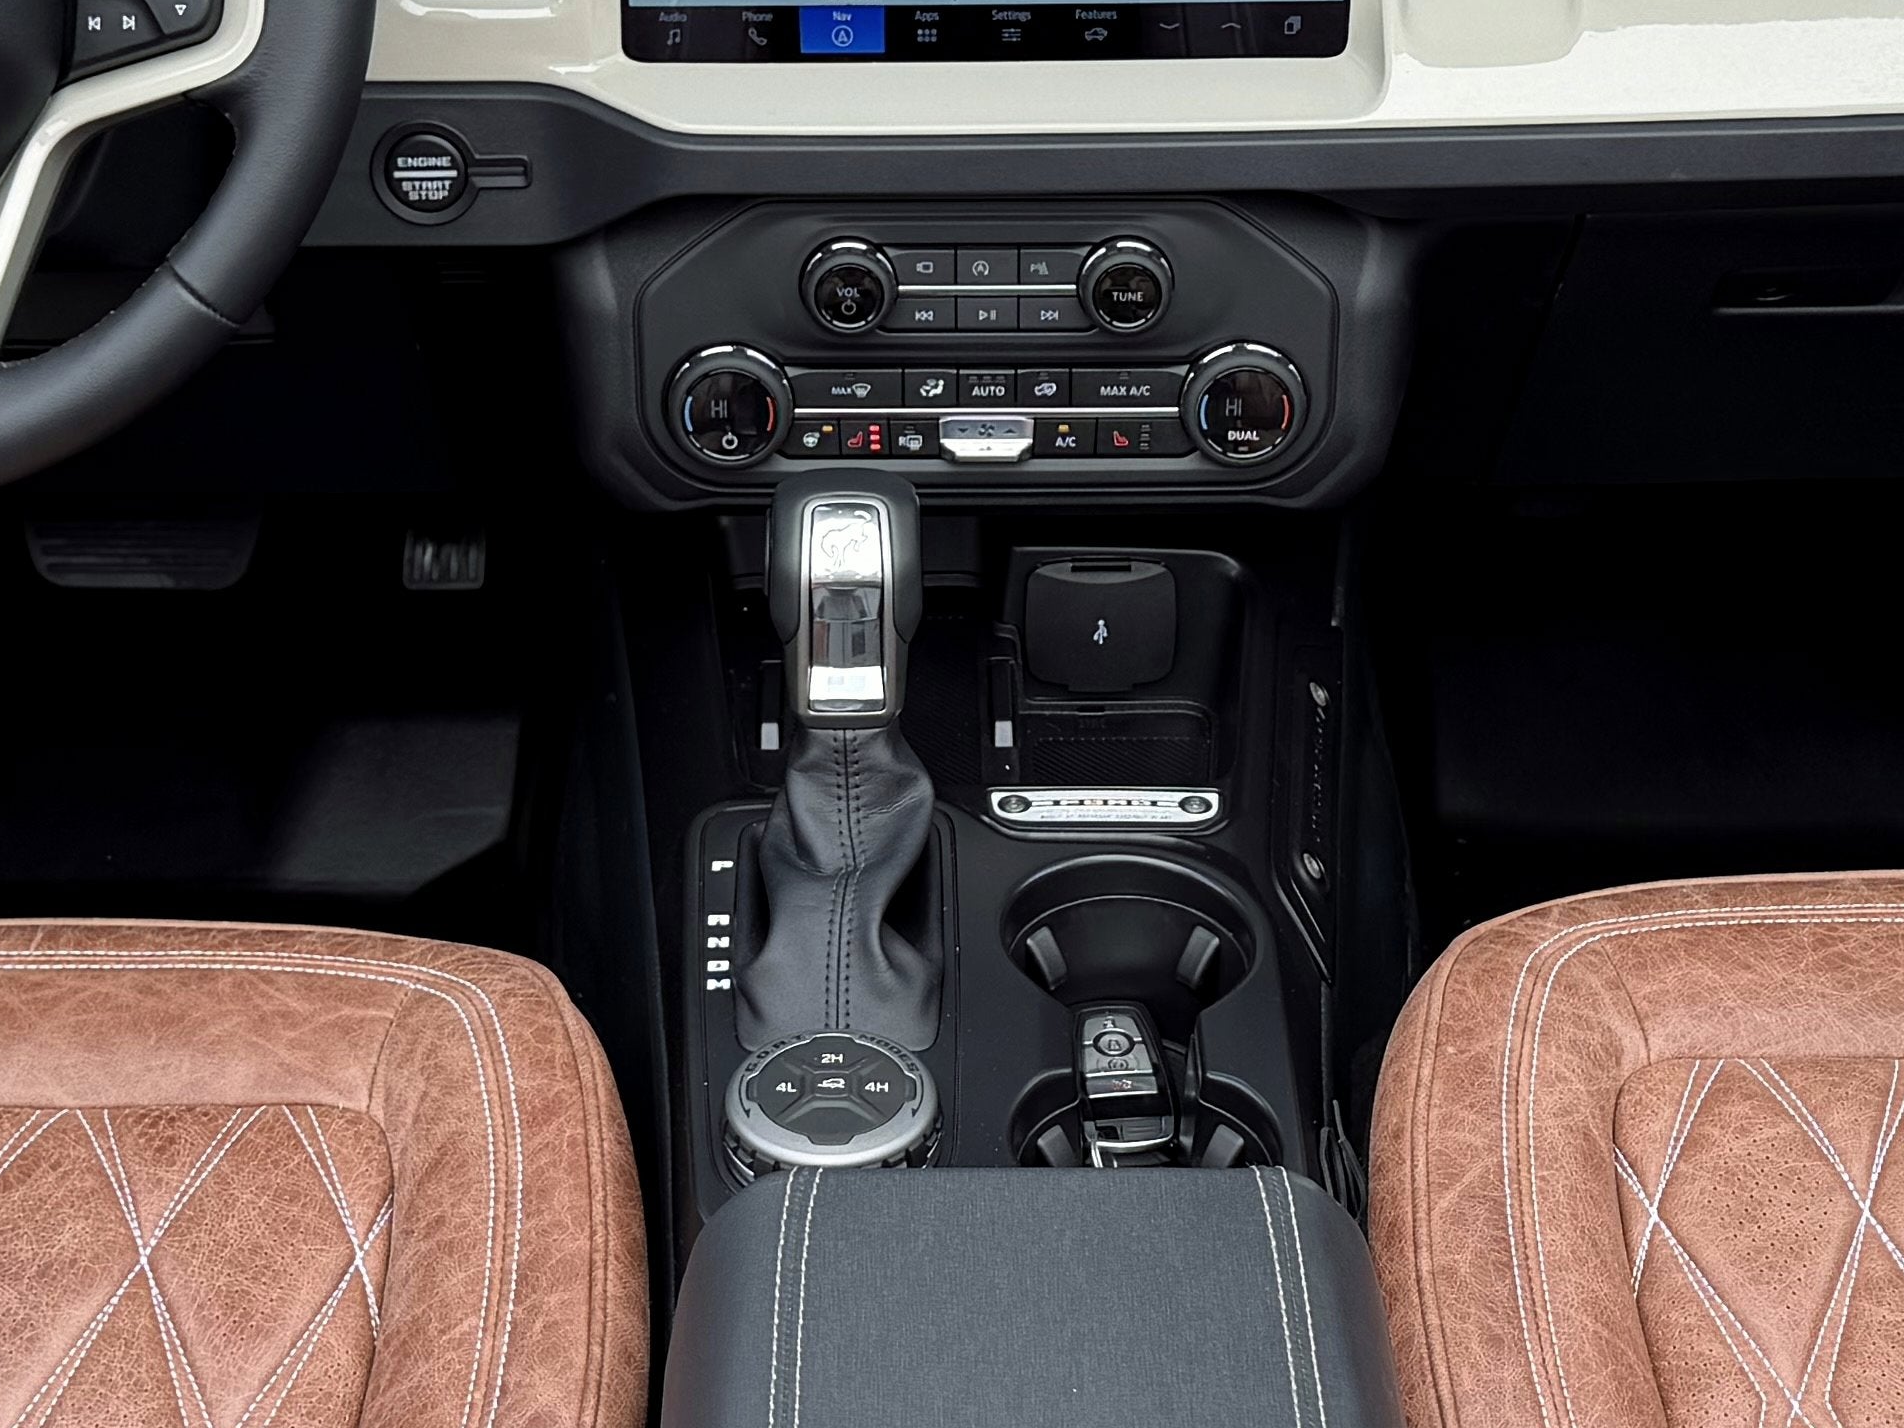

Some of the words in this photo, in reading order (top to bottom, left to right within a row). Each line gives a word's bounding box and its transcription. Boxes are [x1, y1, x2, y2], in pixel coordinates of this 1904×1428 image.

[659, 11, 687, 22] Audio
[742, 11, 773, 22] Phone
[833, 10, 852, 22] Nav
[914, 10, 939, 24] Apps
[992, 8, 1032, 23] Settings
[1075, 8, 1117, 21] Features
[397, 156, 452, 168] ENGINE
[402, 179, 453, 191] START
[408, 190, 449, 201] STOP
[836, 287, 860, 298] VOL
[1112, 290, 1144, 302] TUNE
[831, 385, 852, 395] MAX
[971, 385, 1005, 397] AUTO
[1100, 385, 1127, 397] MAX
[1129, 384, 1151, 398] A/C
[710, 399, 728, 418] HI
[1225, 398, 1242, 418] HI
[1227, 429, 1260, 442] DUAL
[1055, 436, 1076, 448] A/C
[711, 860, 734, 872] P
[707, 978, 731, 990] M
[820, 1053, 844, 1064] 2H
[775, 1082, 797, 1093] 4L
[864, 1081, 889, 1093] 4H
